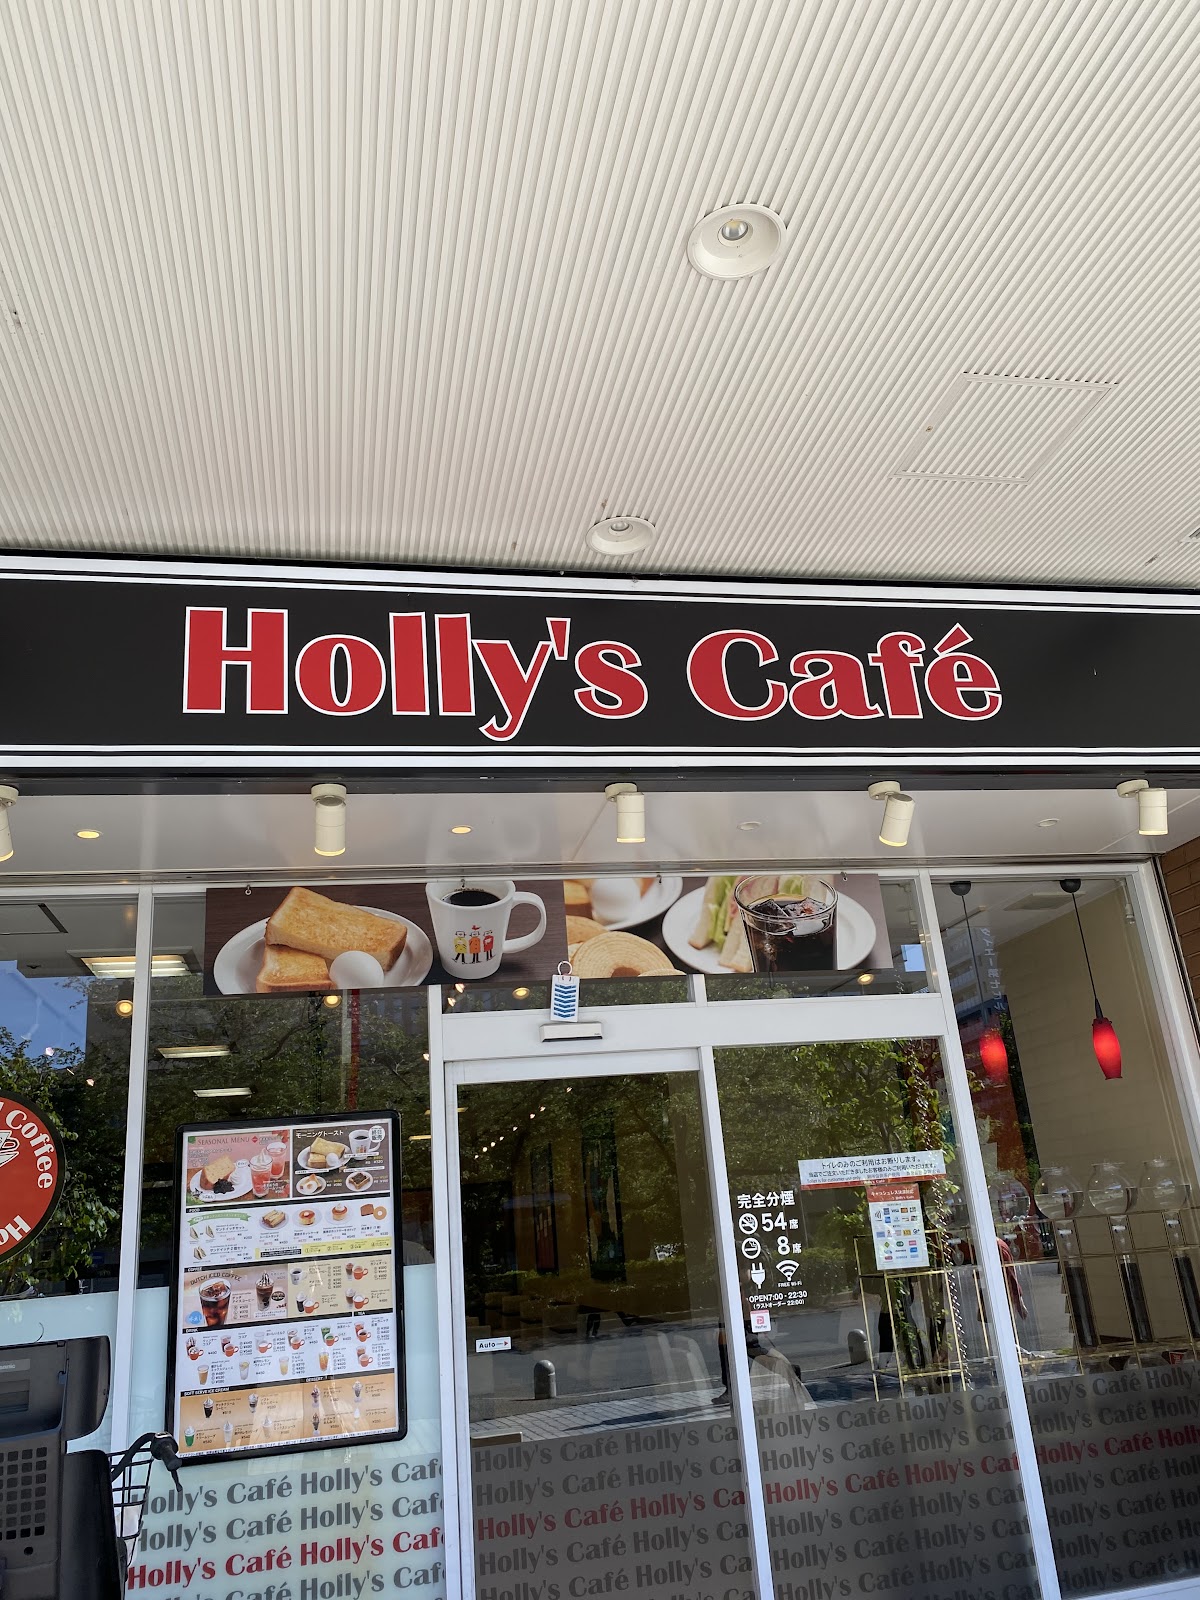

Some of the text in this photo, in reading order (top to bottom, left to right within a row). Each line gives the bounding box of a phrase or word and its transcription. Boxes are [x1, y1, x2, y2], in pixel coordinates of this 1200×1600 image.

[182, 606, 1003, 741] Holly's Café
[5, 1109, 55, 1189] Coffee
[197, 1137, 229, 1146] SEASONAL
[230, 1136, 250, 1144] MENU
[296, 1130, 344, 1138] モーニングトースト
[821, 1155, 921, 1170] トイレのみのご利用はお断りします。
[737, 1190, 795, 1209] 完全分煙
[190, 1275, 208, 1286] DUTCH
[221, 1273, 242, 1282] COFFEE
[787, 1290, 808, 1299] 22:30
[1093, 1373, 1141, 1395] Café
[1146, 1365, 1200, 1389] Holly'
[758, 1413, 830, 1439] Holly's
[836, 1404, 891, 1430] Café
[896, 1396, 964, 1422] Holly's
[1099, 1402, 1147, 1425] Café
[475, 1444, 552, 1472] Holly's
[560, 1435, 618, 1462] Café
[625, 1426, 699, 1453] Holly's
[762, 1444, 834, 1471] Holly's
[840, 1435, 895, 1461] Café
[900, 1427, 969, 1453] Holly's
[1104, 1432, 1154, 1456] Café
[226, 1475, 292, 1504] Café
[301, 1465, 383, 1495] Holly's
[391, 1458, 443, 1483] Caf
[476, 1477, 554, 1506] Holly's
[562, 1467, 621, 1495] Café
[627, 1458, 702, 1486] Holly's
[765, 1476, 839, 1504] Holly's
[845, 1467, 900, 1493] Café
[905, 1458, 975, 1485] Holly's
[1110, 1462, 1160, 1486] Café
[226, 1510, 292, 1540] Café
[301, 1500, 383, 1530] Holly's
[392, 1493, 443, 1518] Caf
[477, 1511, 556, 1541] Holly's
[564, 1500, 624, 1528] Café
[630, 1491, 706, 1520] Holly's
[769, 1509, 843, 1537] Holly's
[850, 1498, 904, 1526] Café
[910, 1490, 980, 1518] Holly's
[1116, 1493, 1168, 1517] Café
[479, 1545, 558, 1576] Holly's
[566, 1534, 626, 1562] Café
[633, 1524, 709, 1553] Holly's
[773, 1542, 848, 1571] Holly's
[854, 1531, 909, 1559] Café
[915, 1522, 985, 1549] Holly's
[1122, 1523, 1173, 1548] Café
[127, 1527, 445, 1590] Holly's Café Holly's Caf
[568, 1568, 629, 1597] Café
[636, 1558, 712, 1588] Holly's
[777, 1576, 852, 1600] Holly's
[859, 1565, 914, 1593] Café
[919, 1555, 991, 1583] Holly's
[1128, 1554, 1180, 1580] Café
[1183, 1551, 1200, 1571] H
[301, 1570, 384, 1600] Holly's
[393, 1562, 445, 1588] Caf
